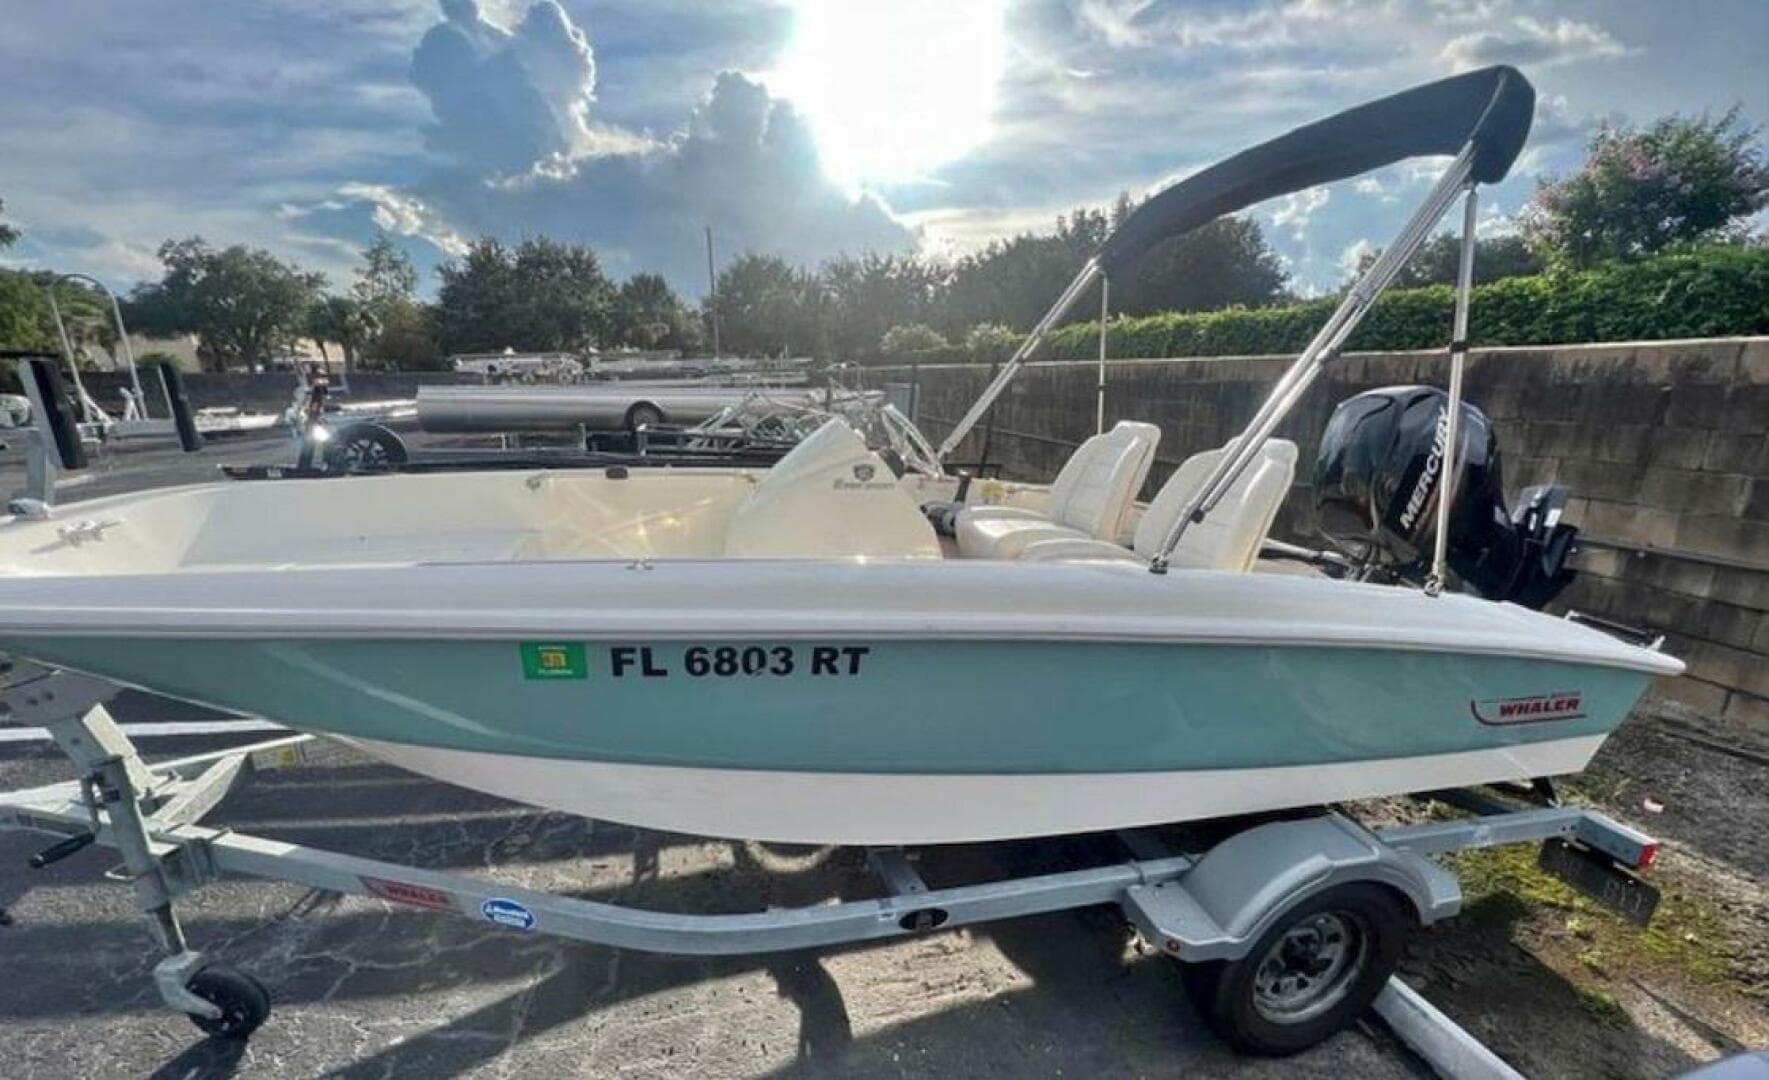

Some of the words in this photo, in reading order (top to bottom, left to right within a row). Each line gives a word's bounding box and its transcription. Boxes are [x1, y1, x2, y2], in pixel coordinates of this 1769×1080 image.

[1400, 405, 1448, 529] MERCURY
[610, 647, 668, 677] FL
[684, 647, 795, 677] 6803
[810, 646, 871, 675] RT
[1499, 699, 1579, 716] WHALER
